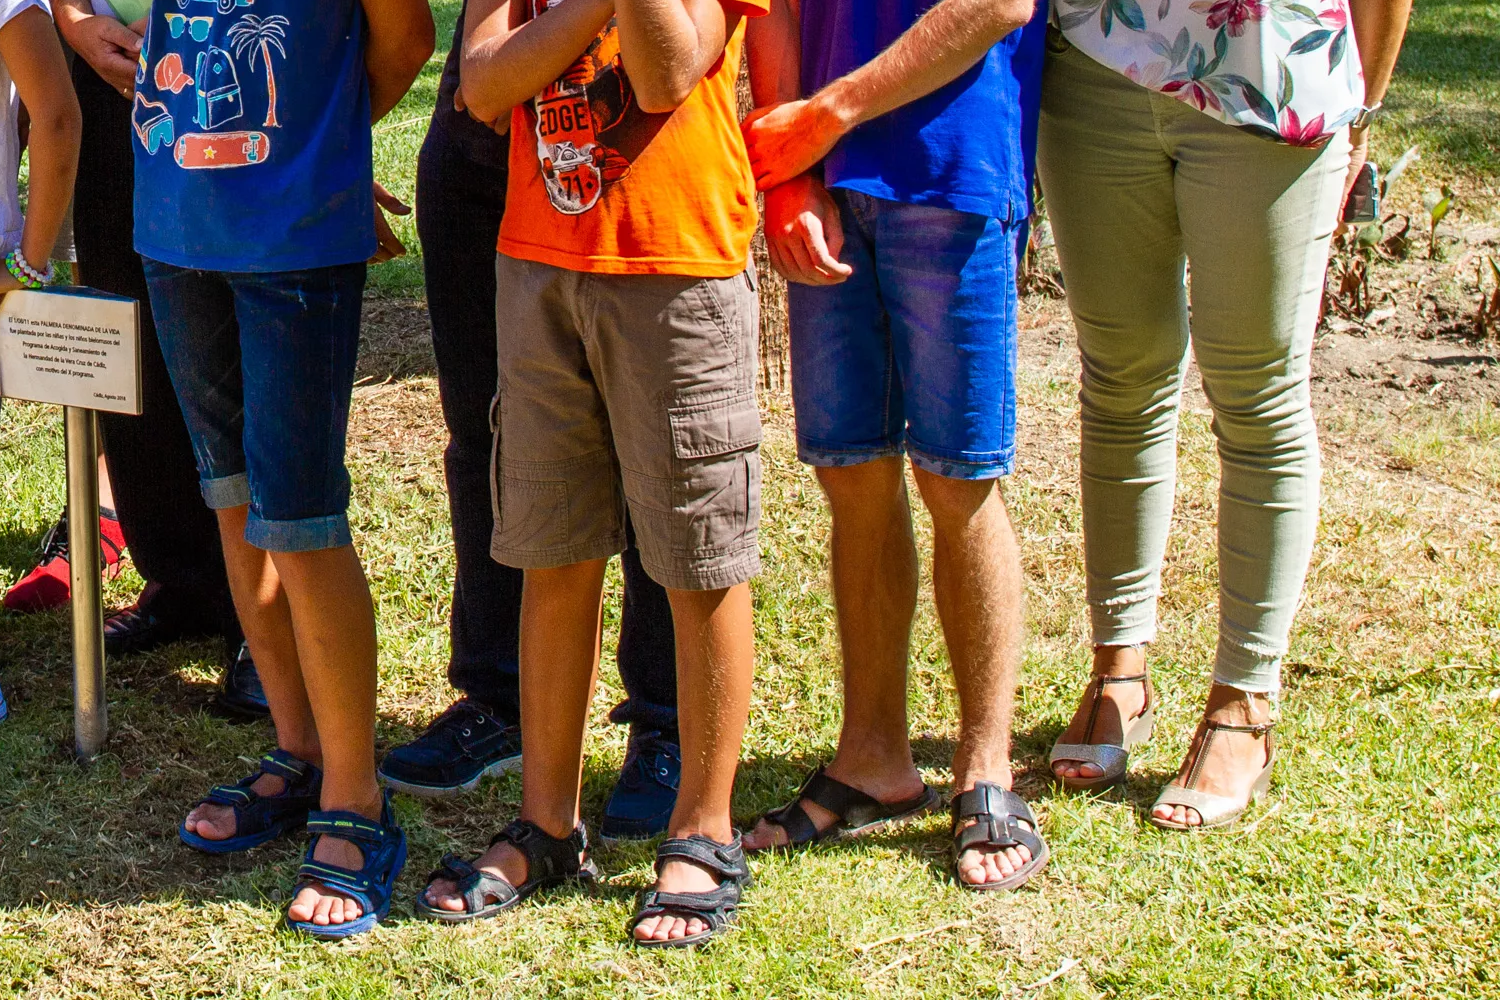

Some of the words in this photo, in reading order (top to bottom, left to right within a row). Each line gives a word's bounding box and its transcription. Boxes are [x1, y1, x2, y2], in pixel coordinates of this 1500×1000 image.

[539, 102, 589, 137] EDGE
[561, 174, 585, 201] 71
[40, 320, 62, 328] PALMERA
[63, 323, 94, 332] DENOMINADA
[17, 329, 36, 337] plantada
[22, 341, 43, 349] Programa
[50, 344, 68, 352] Acogida
[72, 346, 100, 355] Saneamiento
[28, 353, 53, 362] Hermandad
[72, 370, 95, 378] programa.
